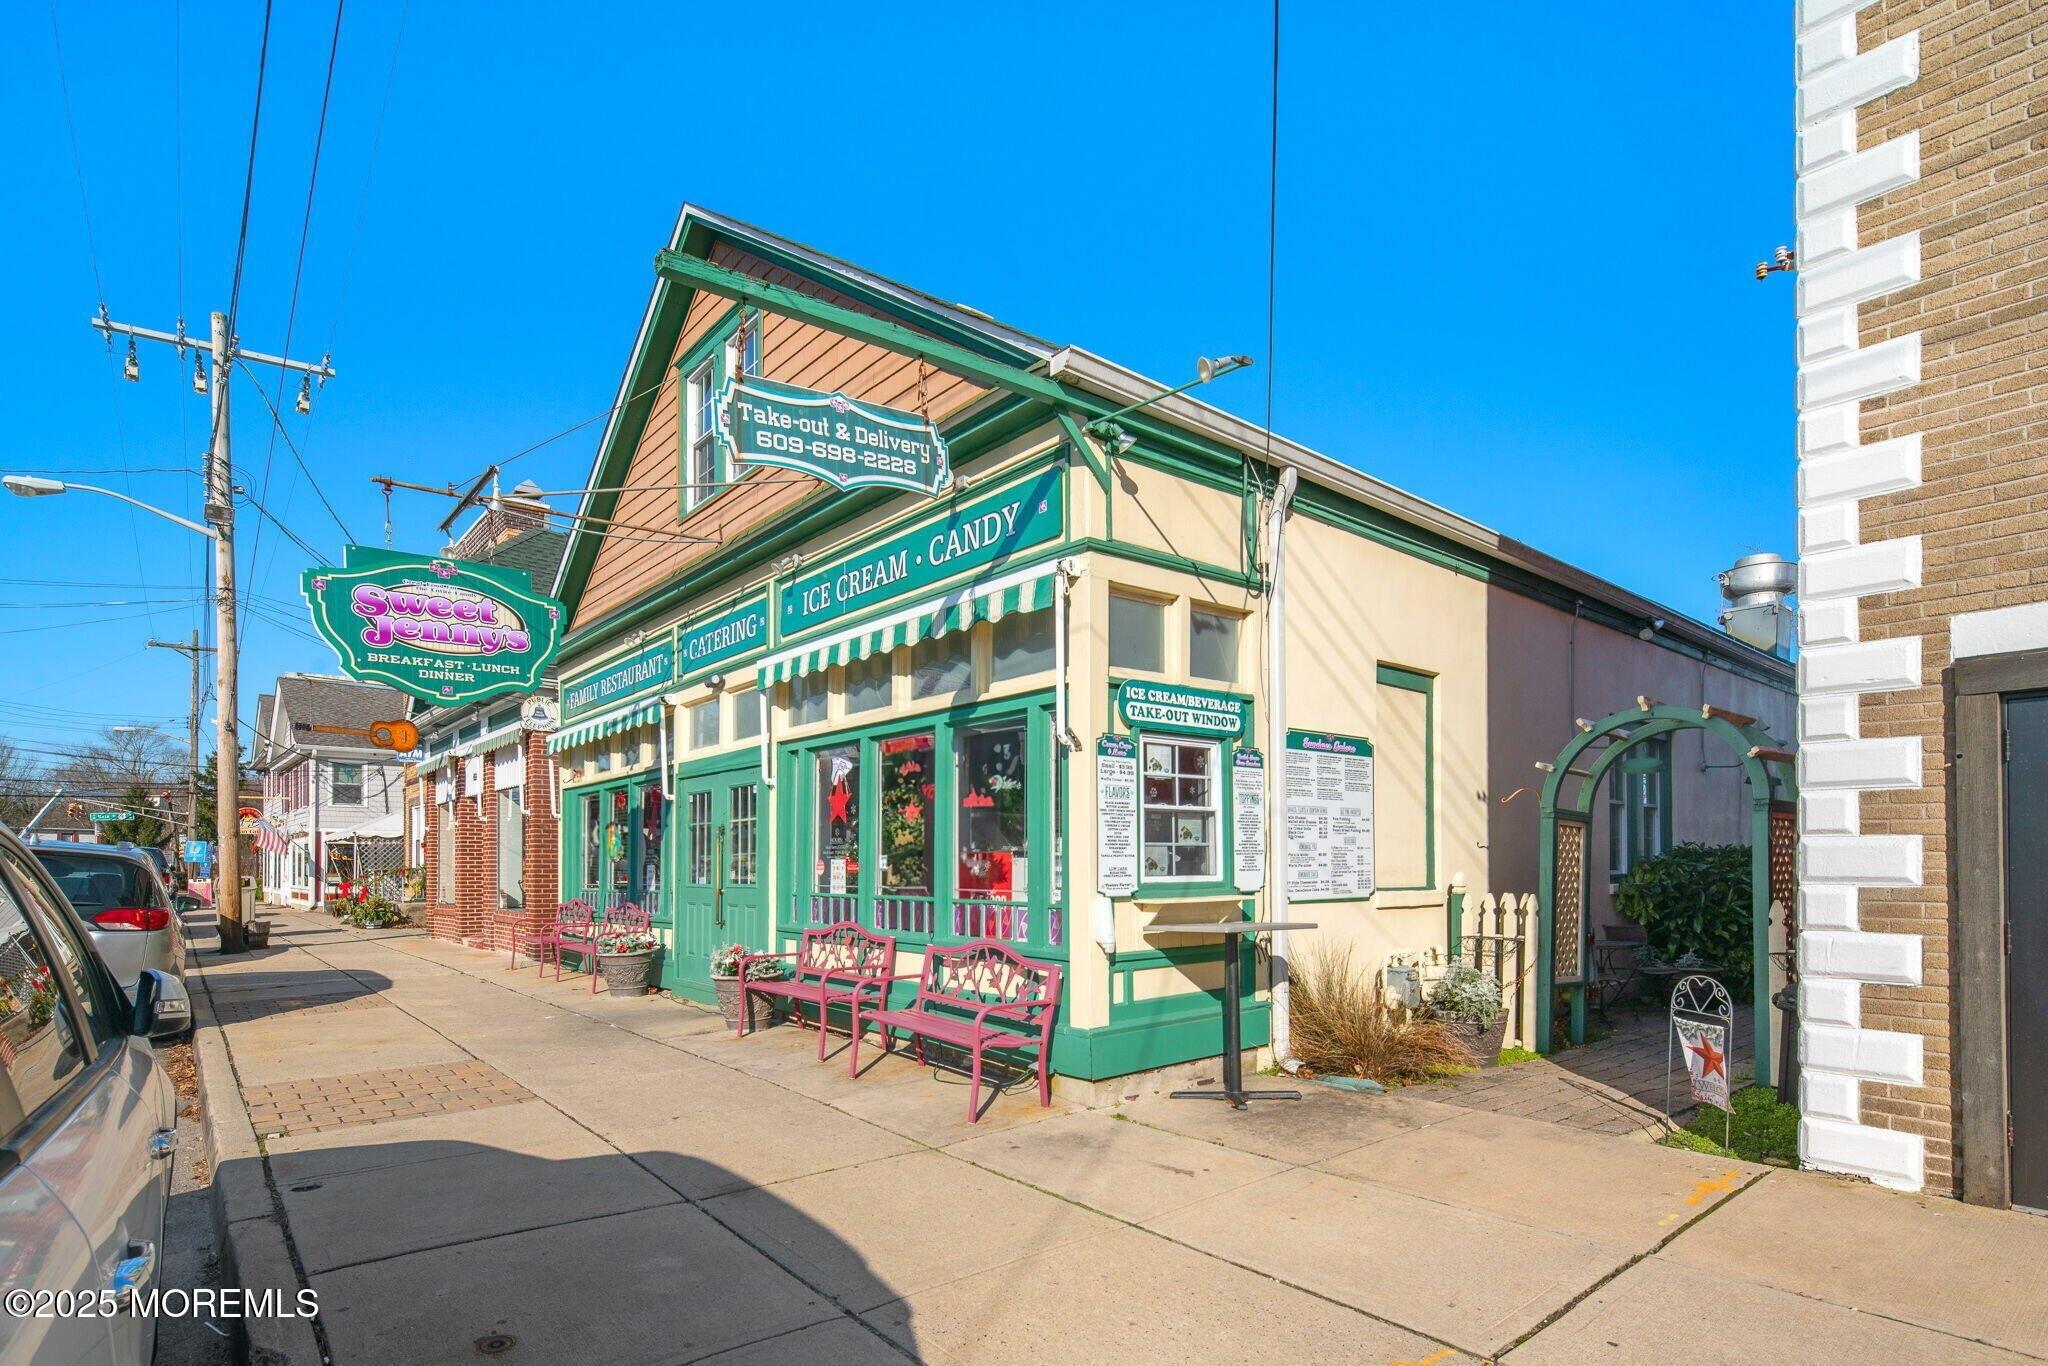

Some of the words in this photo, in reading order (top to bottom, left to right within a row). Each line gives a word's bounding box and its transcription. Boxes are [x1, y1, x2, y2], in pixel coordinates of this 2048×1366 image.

[737, 401, 830, 438] Take-out
[835, 422, 850, 441] &
[855, 425, 930, 464] Delivery
[756, 430, 917, 475] 609-698-2228
[802, 582, 831, 616] ICE
[836, 549, 908, 602] CREAM
[929, 501, 1021, 566] CANDY
[352, 584, 498, 625] Sweet
[360, 616, 532, 655] Jenny's
[689, 613, 758, 661] CATERING
[367, 652, 465, 670] BREAKFAST
[472, 662, 520, 675] LUNCH
[418, 669, 475, 683] DINNER
[569, 681, 600, 710] FAMILY
[600, 653, 664, 697] RESTAURANT
[526, 696, 553, 707] PUBLIC
[1125, 686, 1146, 700] ICE
[1147, 690, 1241, 713] CREAM/BEVERAGE
[523, 715, 557, 730] TELEPHONE
[1129, 704, 1189, 723] TAKE-OUT
[1191, 712, 1238, 729] WINDOW
[1105, 785, 1130, 799] FLAVORS
